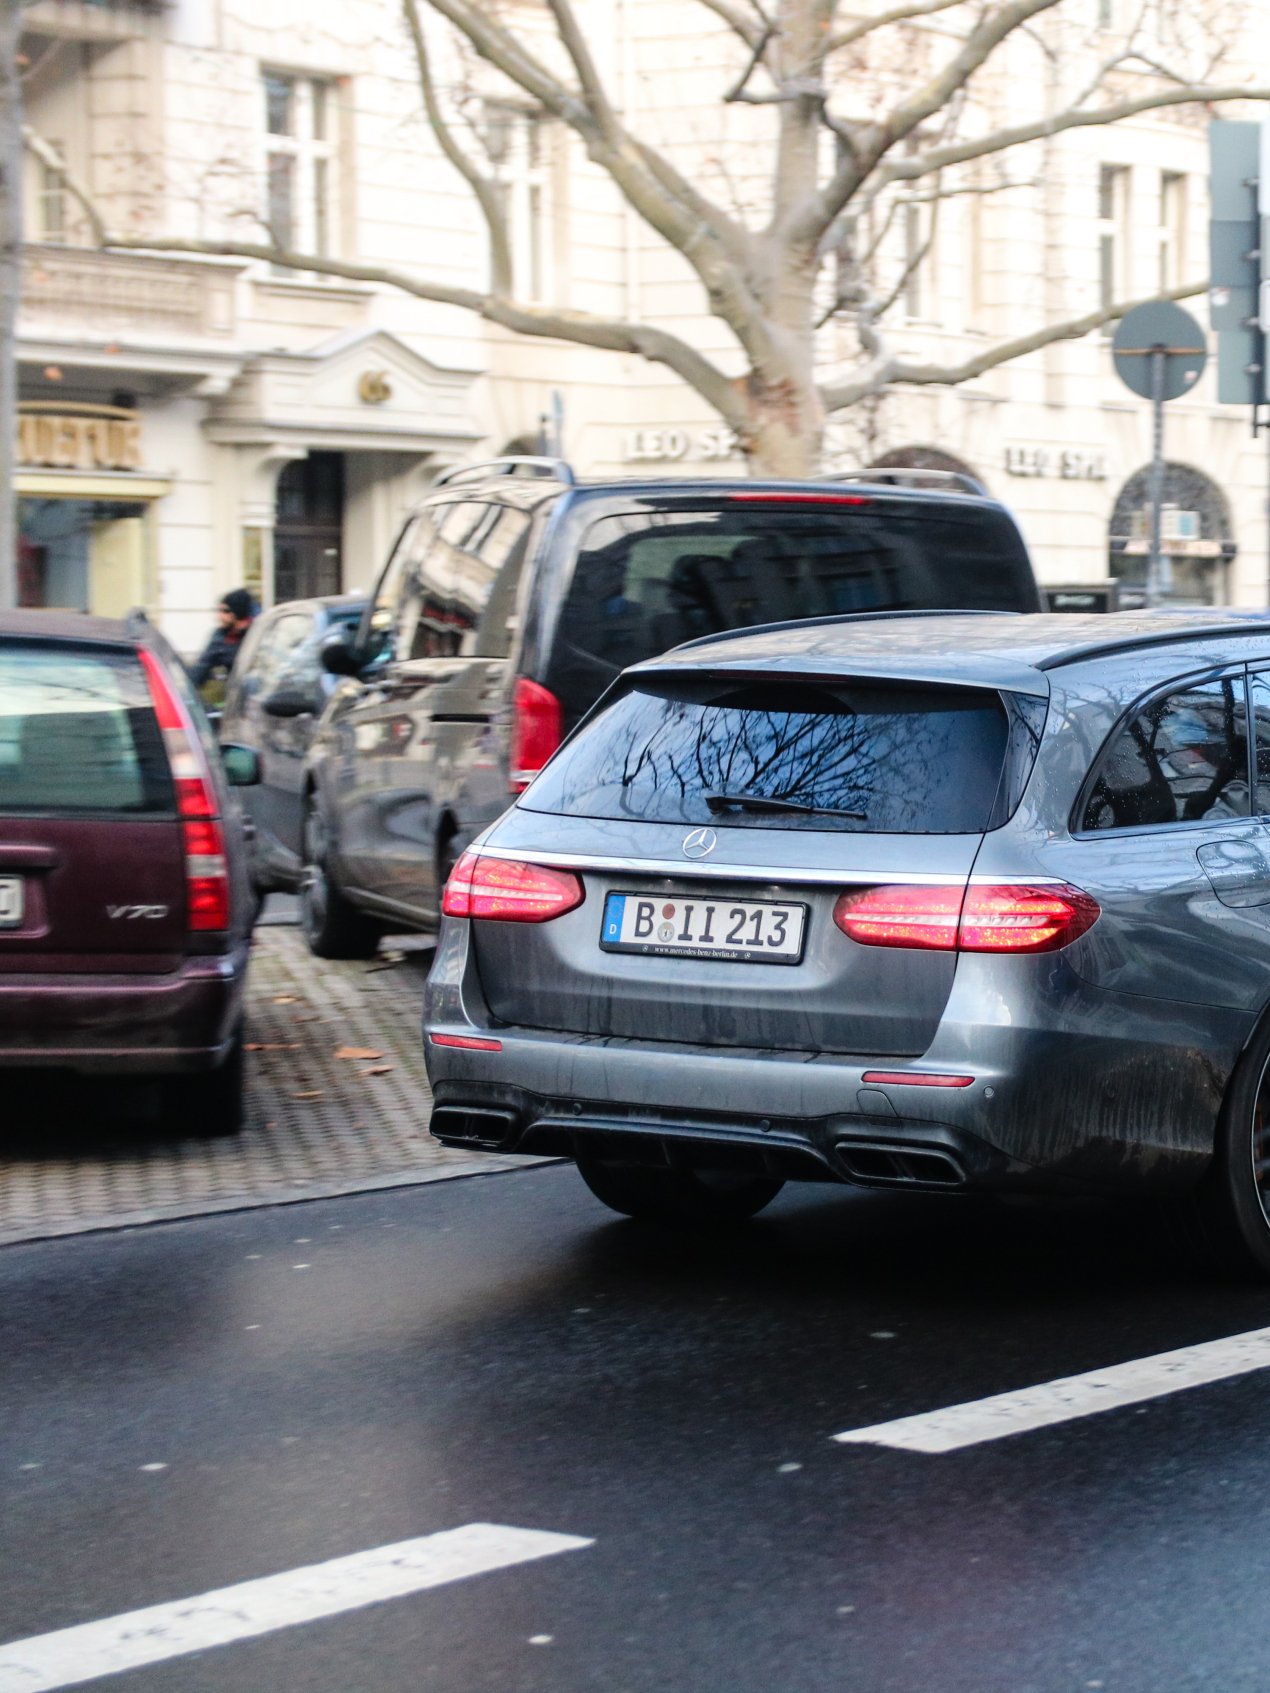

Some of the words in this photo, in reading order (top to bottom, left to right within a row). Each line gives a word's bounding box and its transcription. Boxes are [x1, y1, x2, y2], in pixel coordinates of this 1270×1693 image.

[626, 430, 687, 459] LEO
[106, 904, 169, 920] V70
[609, 923, 618, 935] D
[634, 902, 655, 938] B
[678, 905, 716, 943] II
[726, 908, 789, 947] 213
[654, 945, 739, 959] www.mercedes-benz-berlin.de
